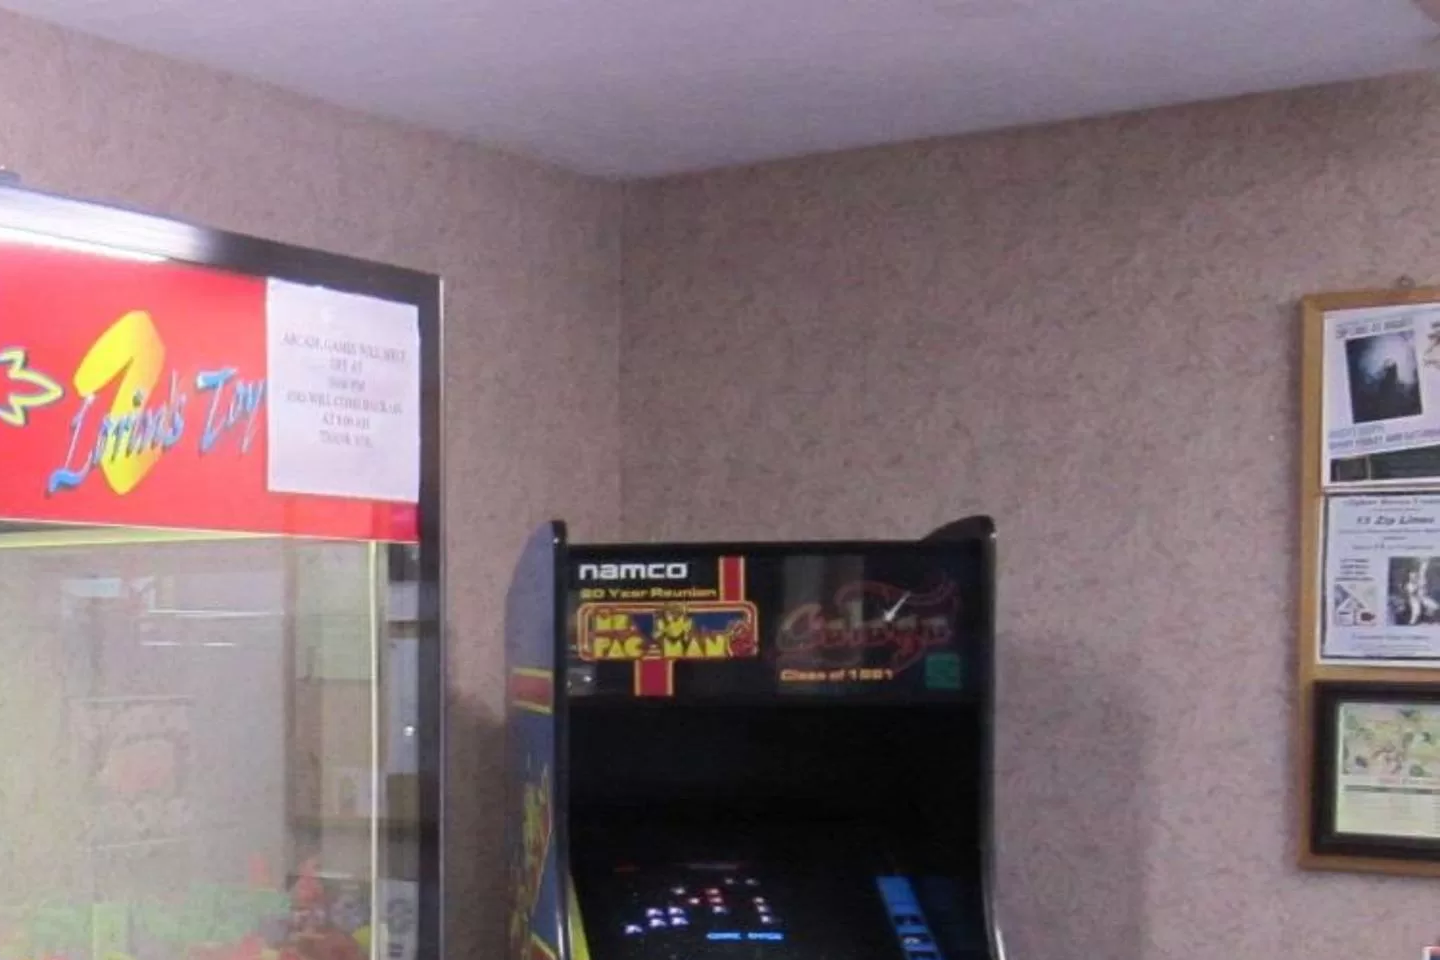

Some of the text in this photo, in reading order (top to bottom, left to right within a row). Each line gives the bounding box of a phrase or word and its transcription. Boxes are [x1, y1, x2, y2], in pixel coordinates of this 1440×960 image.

[579, 563, 688, 580] namco
[608, 588, 648, 599] Year
[651, 587, 717, 599] Reunion
[593, 635, 730, 658] PAC-MAN
[828, 668, 845, 681] of
